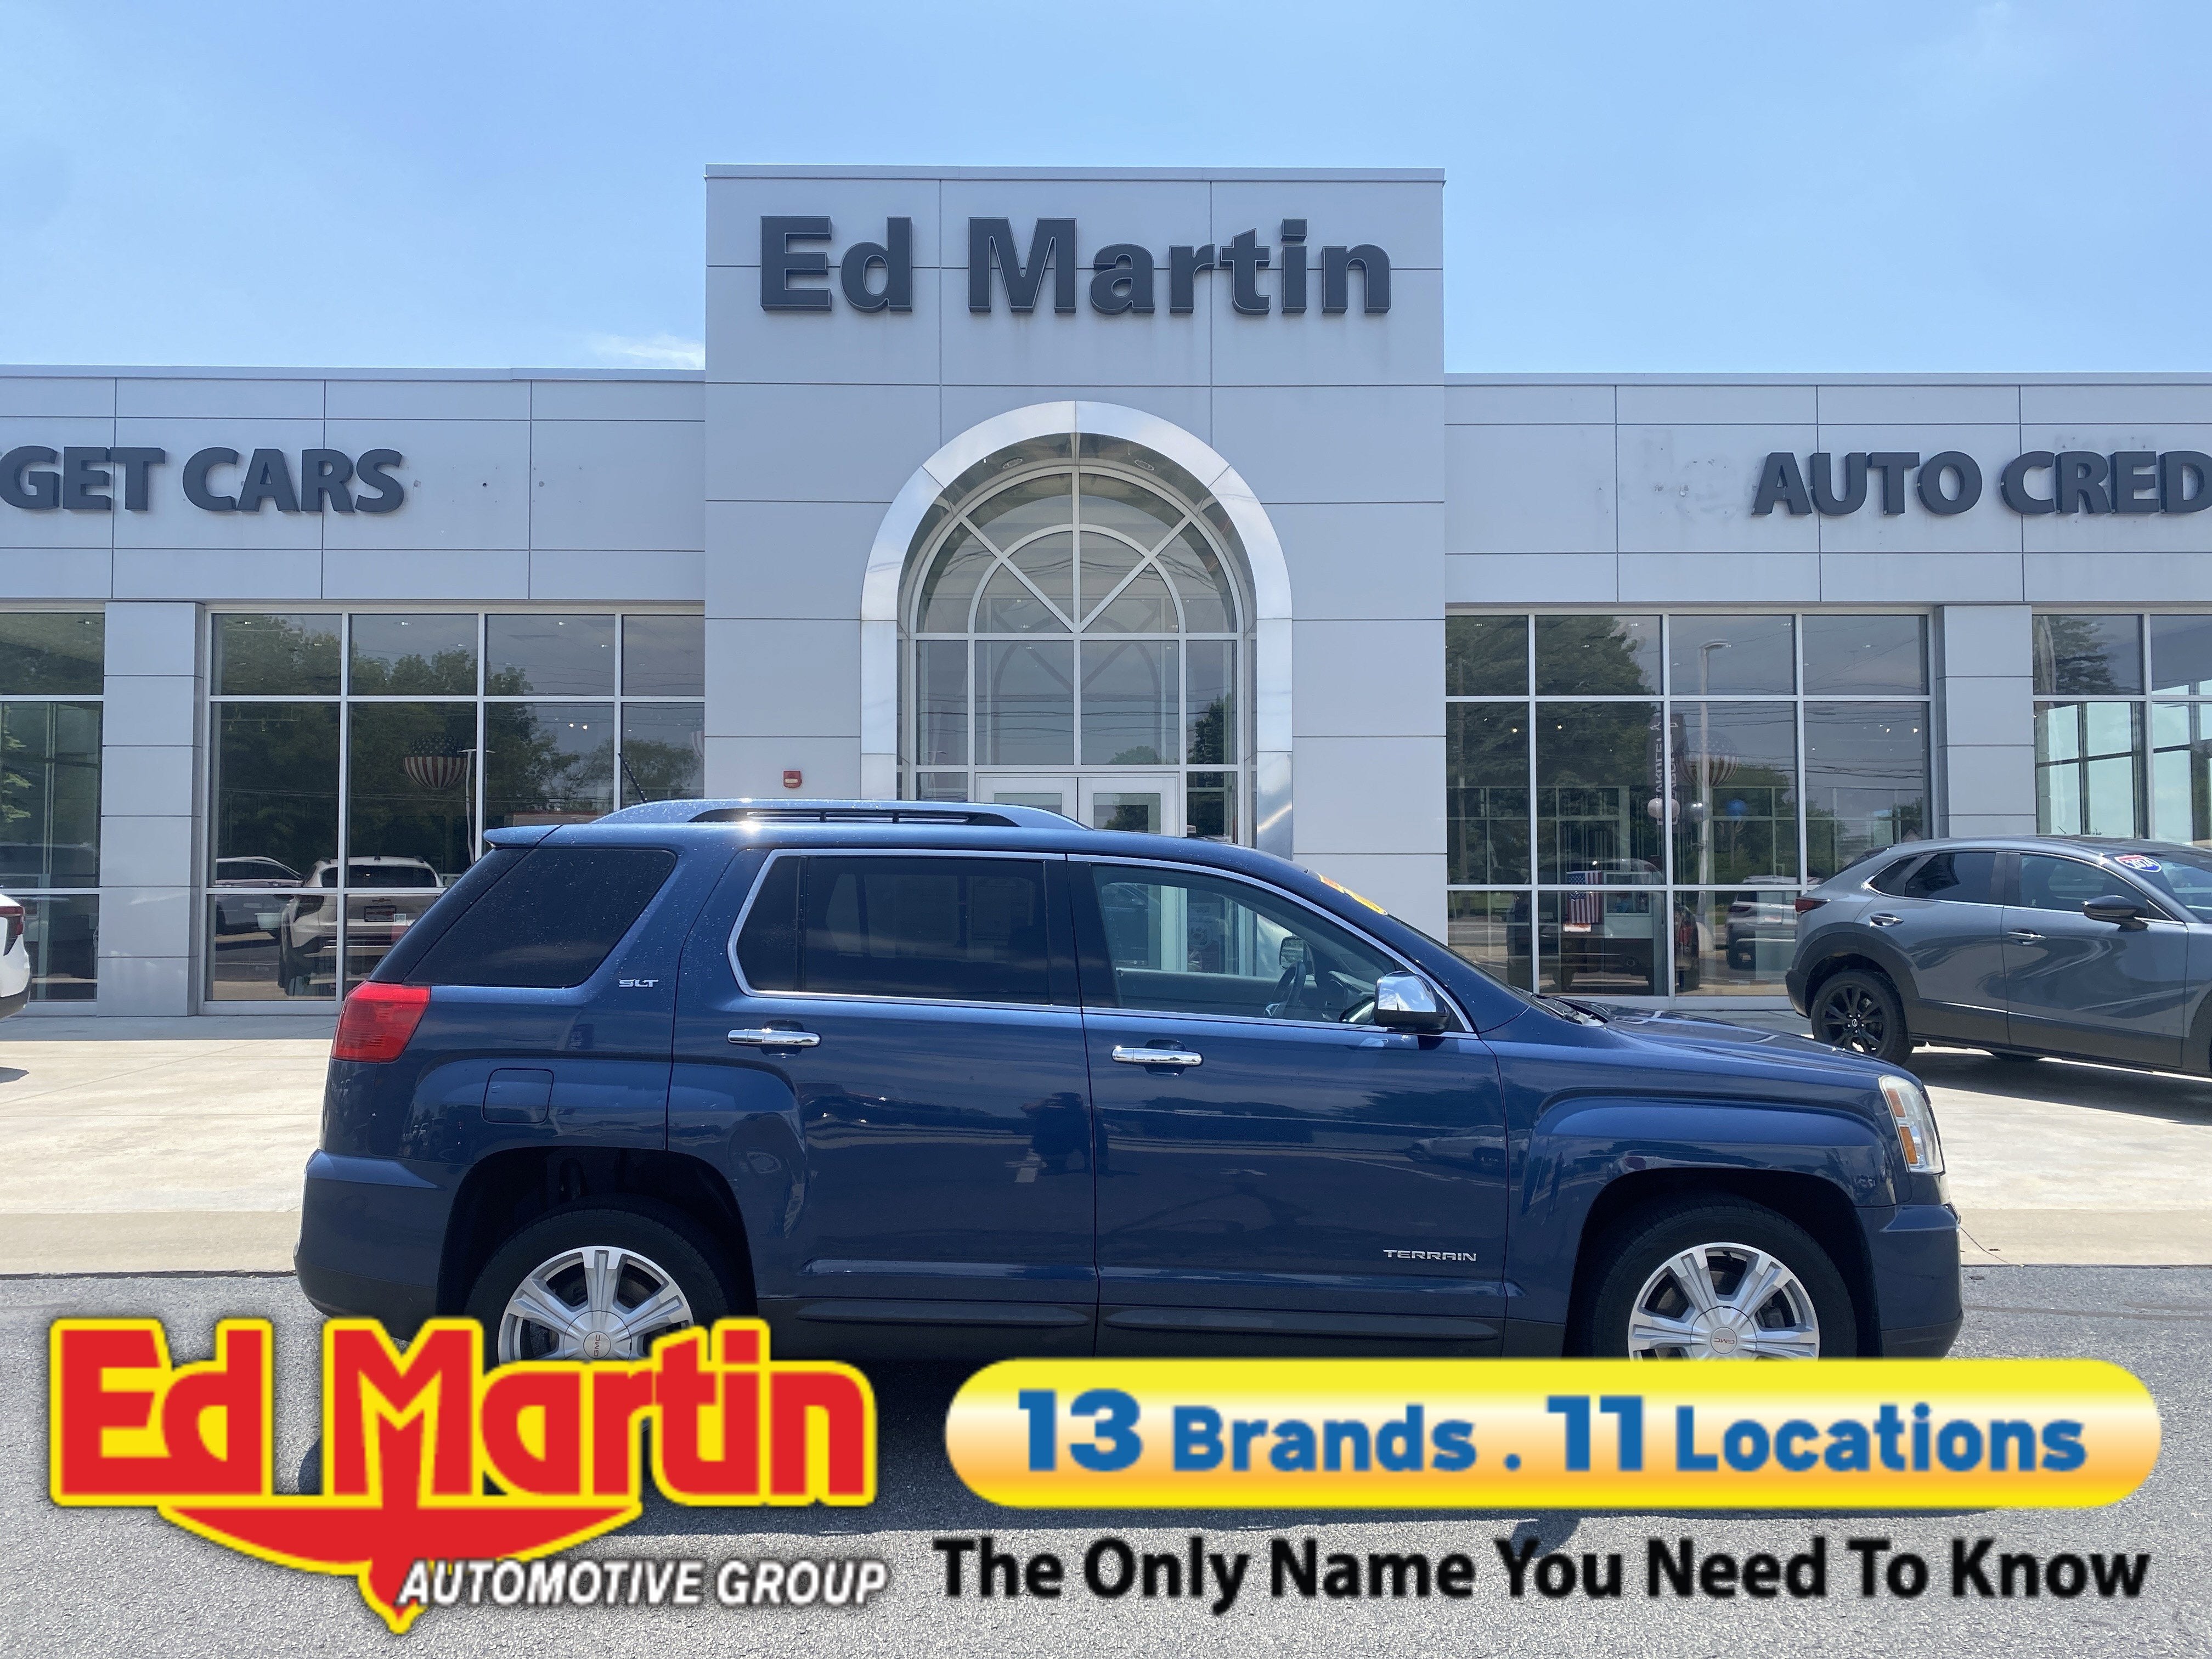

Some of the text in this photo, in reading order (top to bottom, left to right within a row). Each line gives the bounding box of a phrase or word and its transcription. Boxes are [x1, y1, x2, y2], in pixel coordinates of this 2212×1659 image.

[760, 216, 1391, 315] Ed Martin
[182, 447, 405, 514] CARS
[1752, 450, 2212, 516] AUTO CRED
[618, 979, 659, 988] SLT
[1383, 1249, 1477, 1261] TERRAIN
